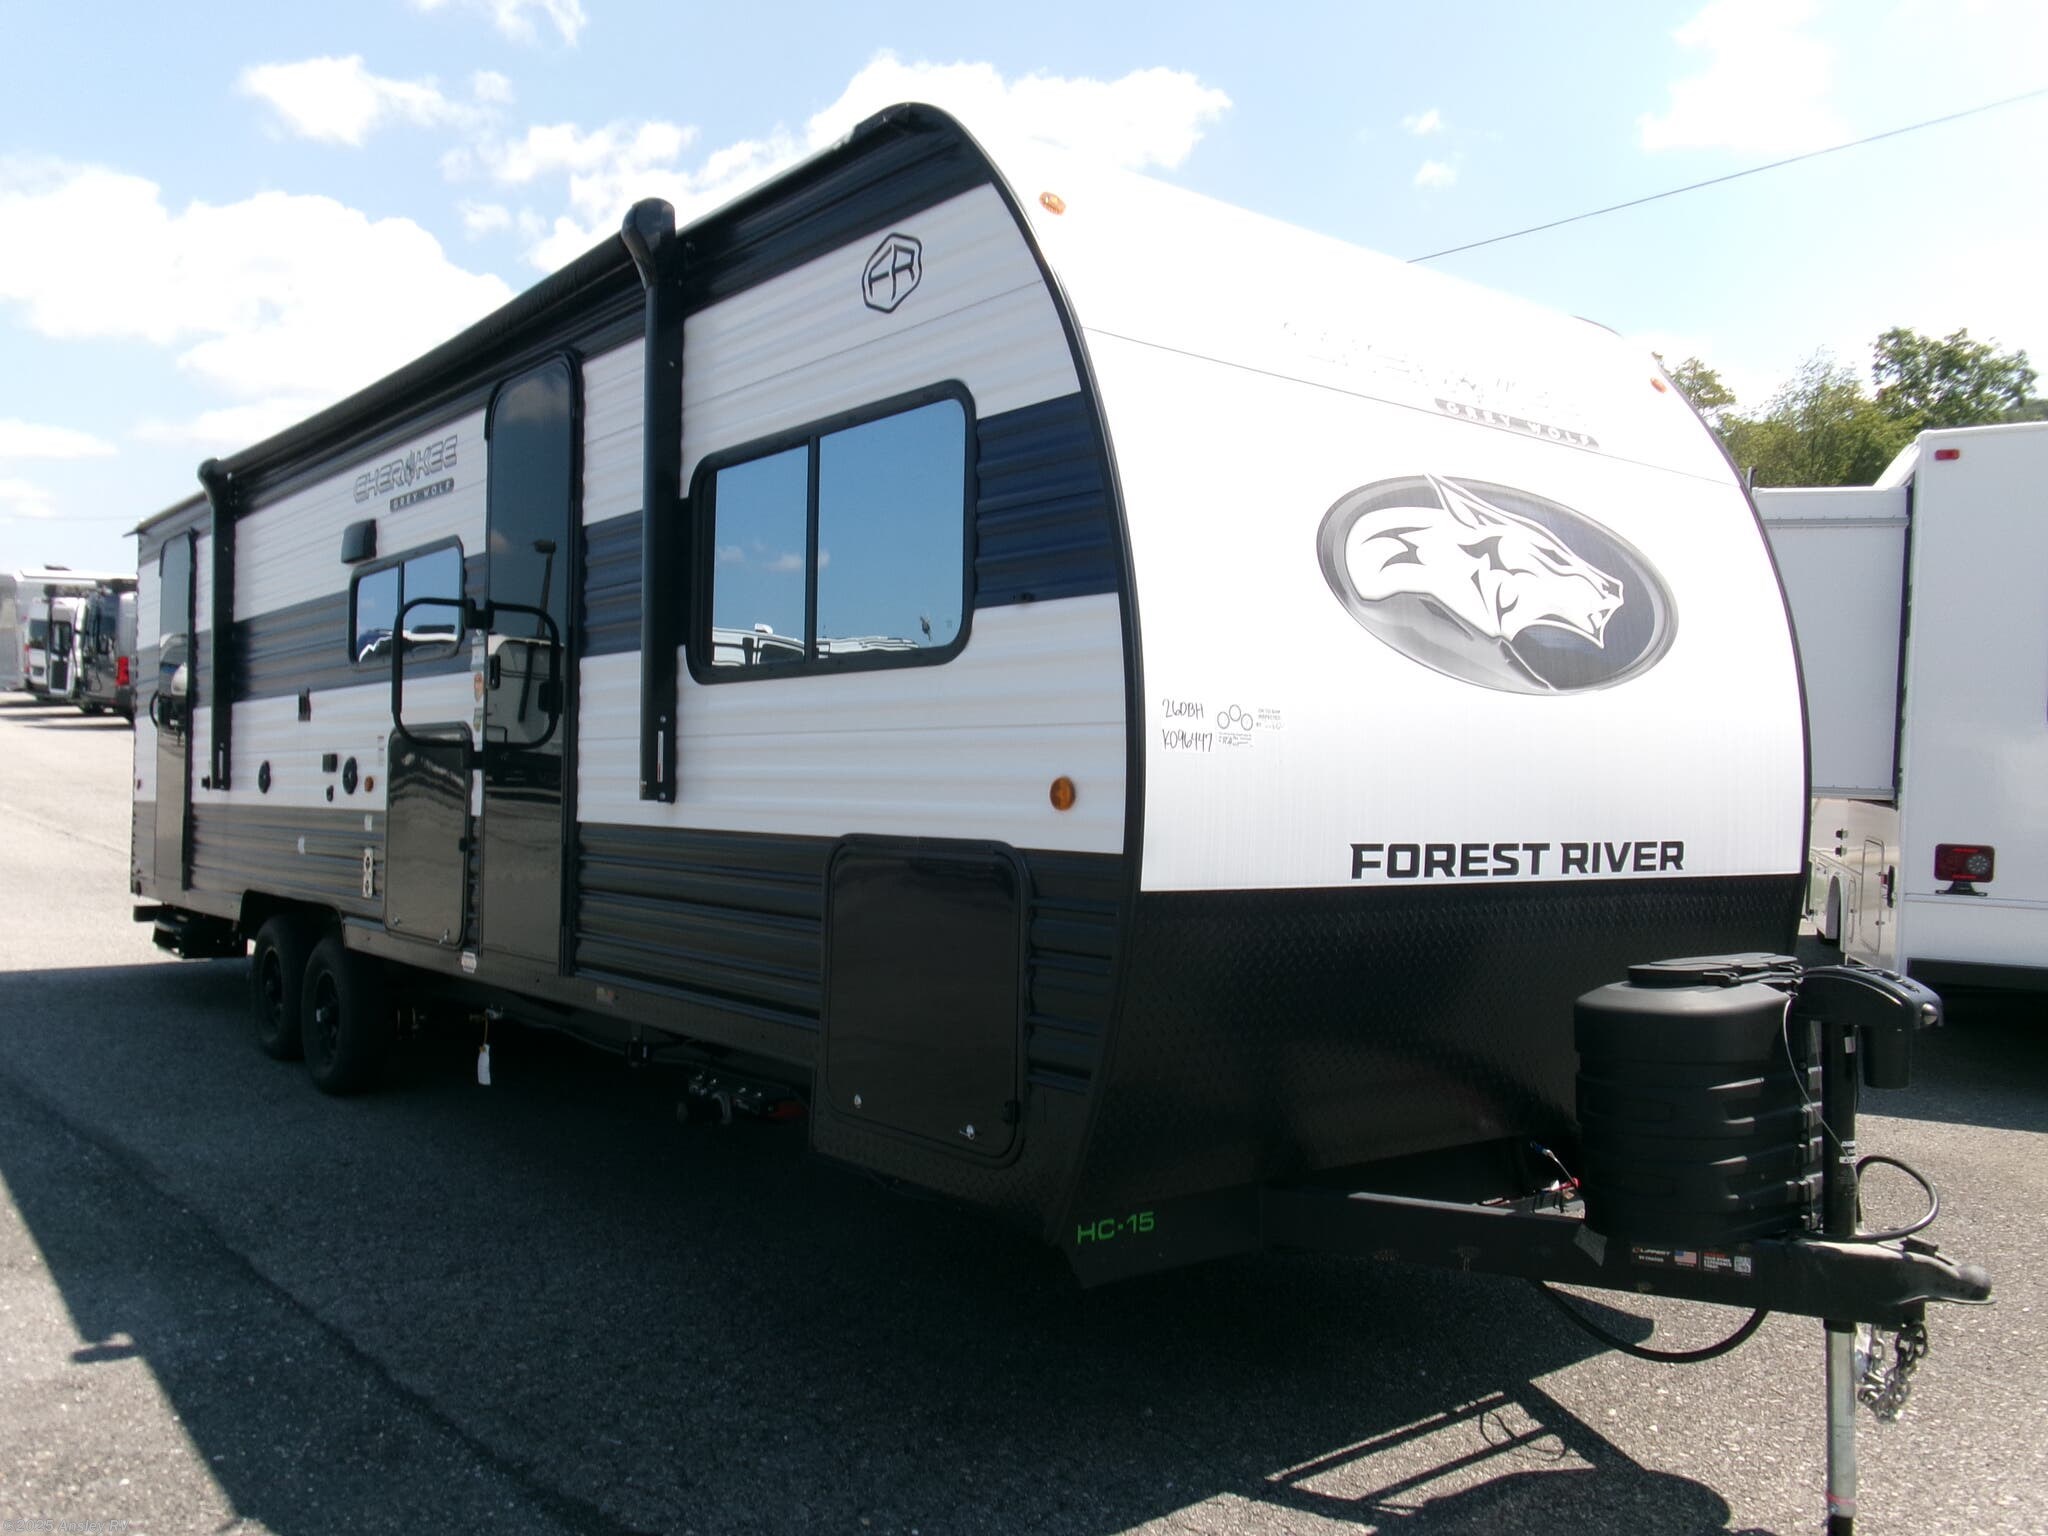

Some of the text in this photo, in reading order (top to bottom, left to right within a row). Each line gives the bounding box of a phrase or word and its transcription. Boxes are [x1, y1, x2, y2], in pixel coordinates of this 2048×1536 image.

[1445, 401, 1591, 446] GREY WOLF
[1349, 840, 1685, 880] FOREST RIVER
